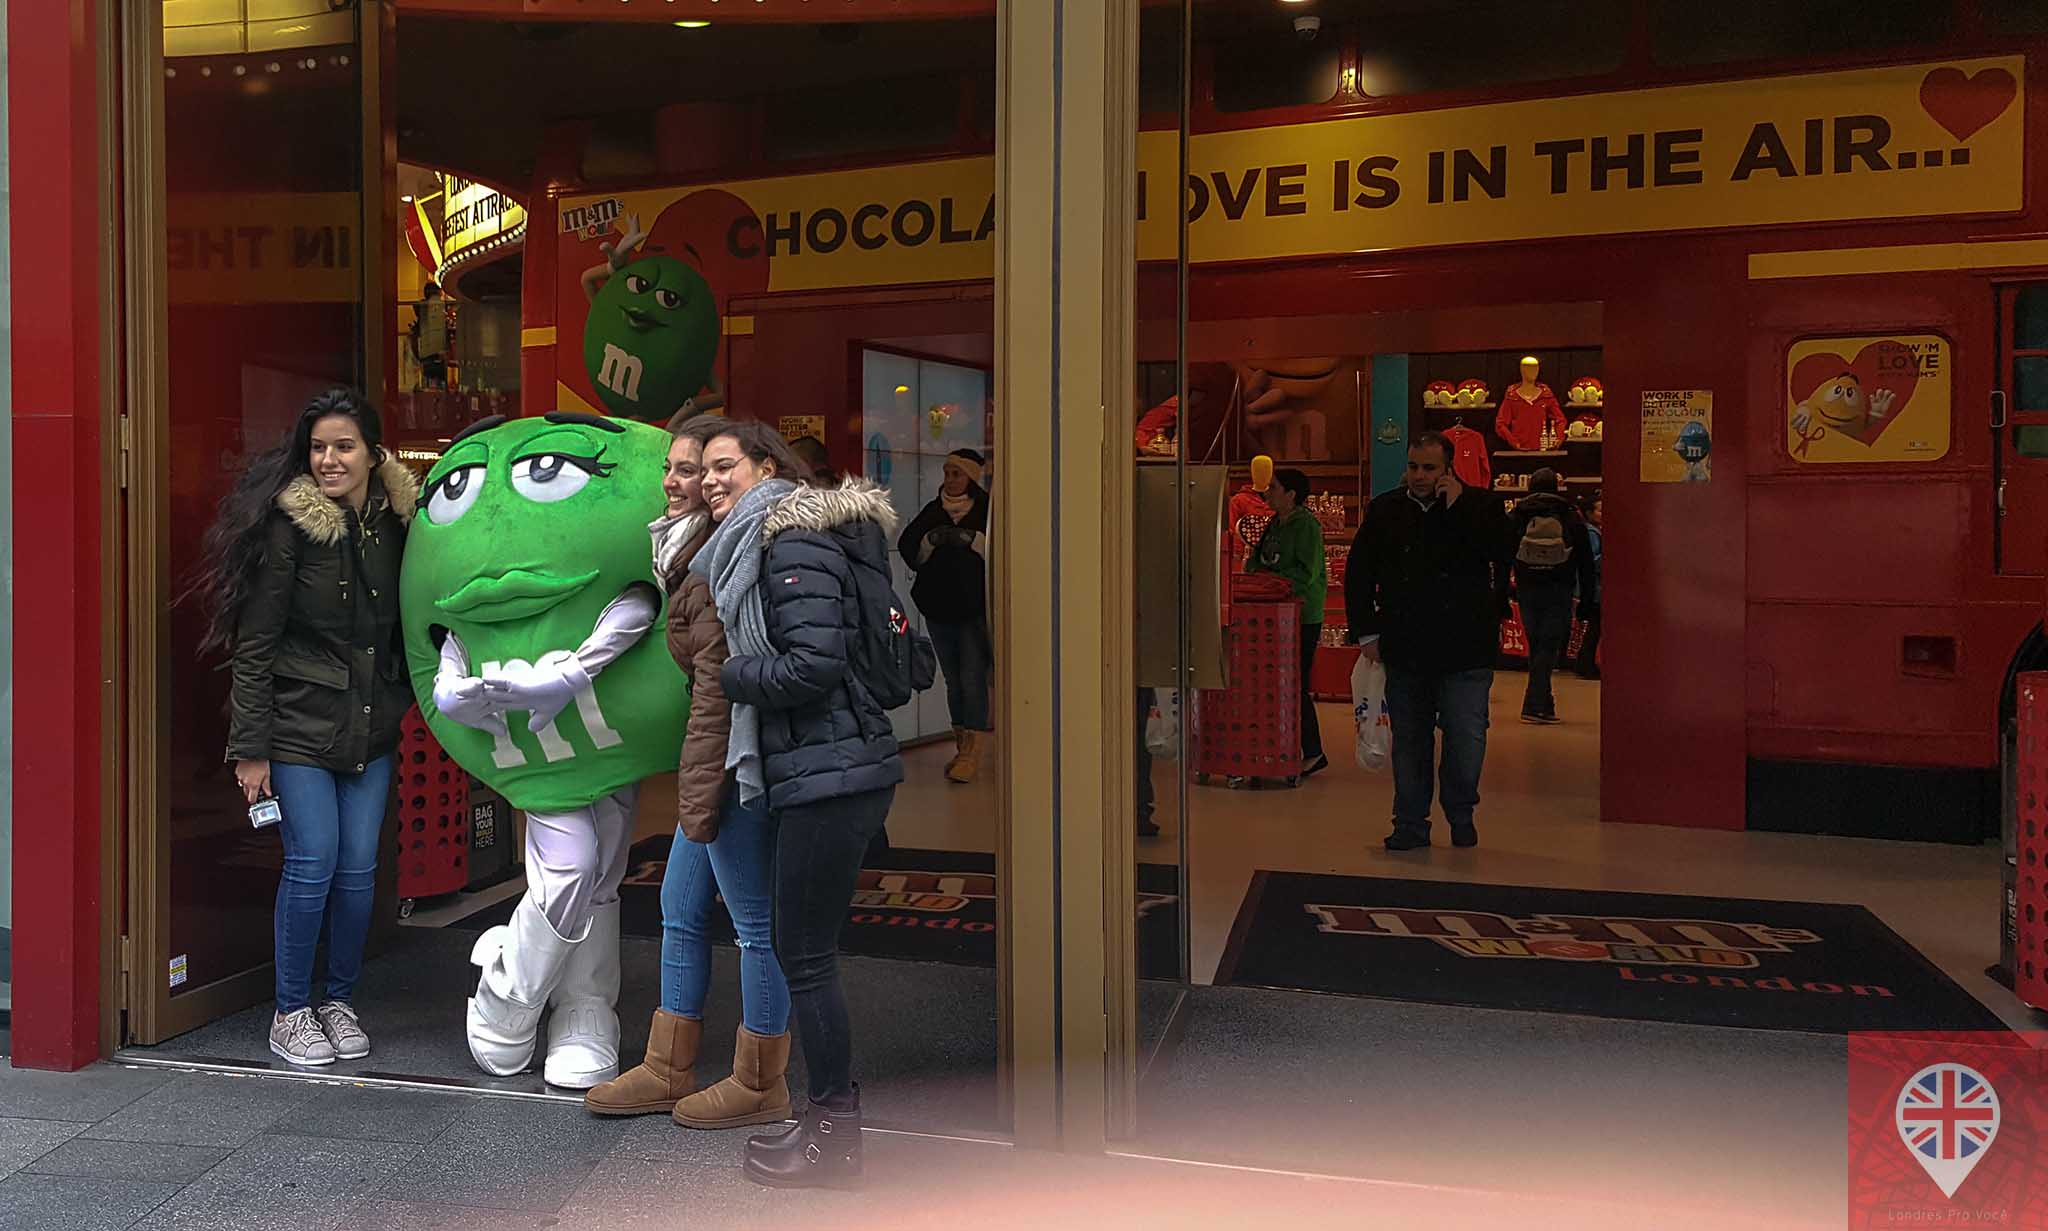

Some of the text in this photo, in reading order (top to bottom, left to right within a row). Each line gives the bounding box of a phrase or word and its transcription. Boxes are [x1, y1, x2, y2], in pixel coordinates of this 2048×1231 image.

[1334, 155, 1400, 212] IS
[1426, 145, 1507, 205] IN
[1534, 127, 1704, 195] THE
[1729, 113, 1971, 182] AIR...
[1878, 353, 1940, 369] LOVE
[1642, 391, 1694, 400] WORK IS
[1643, 409, 1705, 417] IN COLOUR
[475, 805, 493, 821] BAG
[475, 818, 494, 832] YOUR
[475, 834, 495, 848] HERE
[850, 913, 994, 933] ondo
[1617, 966, 1896, 999] London
